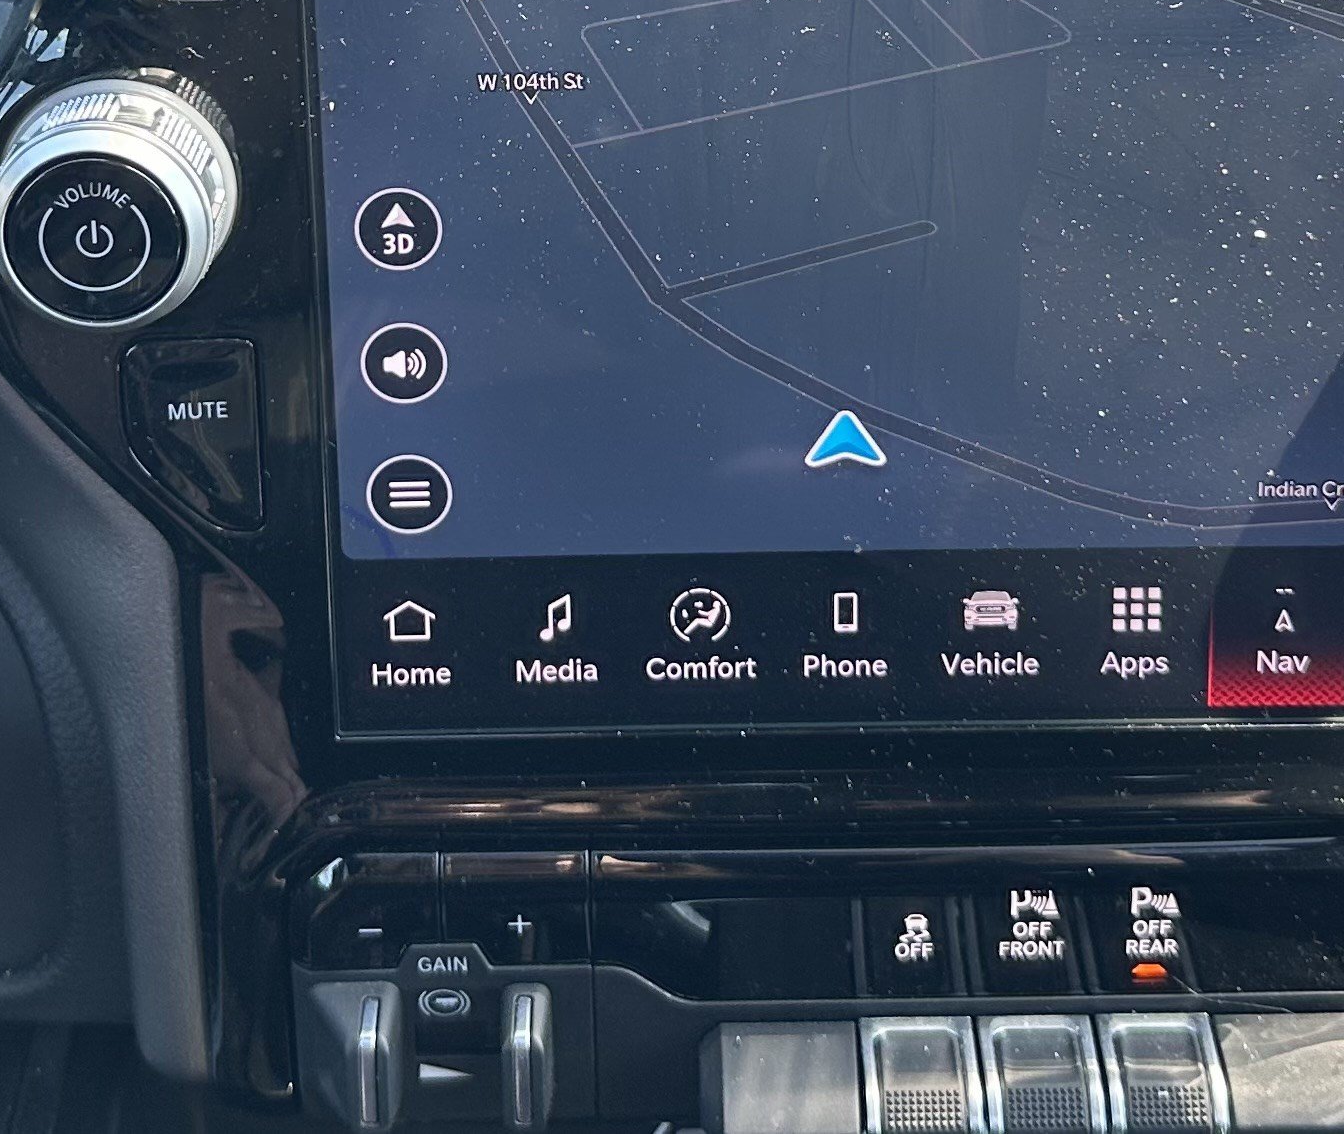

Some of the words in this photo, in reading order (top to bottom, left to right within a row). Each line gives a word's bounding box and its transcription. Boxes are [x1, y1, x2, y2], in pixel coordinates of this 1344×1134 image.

[478, 74, 498, 91] W
[504, 73, 559, 91] 104th
[563, 73, 583, 90] St
[53, 182, 132, 211] VOLUME
[383, 234, 414, 255] 3D
[167, 401, 229, 420] MUTE
[1259, 481, 1318, 497] Indian
[516, 658, 598, 685] Media
[646, 655, 757, 682] Comfort
[803, 654, 889, 679] Phone
[941, 651, 1040, 677] Vehicle
[1101, 651, 1170, 679] Apps
[1256, 650, 1310, 674] Nav
[372, 663, 452, 687] Home
[1012, 921, 1052, 939] OFF
[1132, 919, 1173, 937] OFF
[894, 941, 933, 960] OFF
[999, 940, 1064, 959] FRONT
[1125, 938, 1179, 957] REAR
[418, 957, 468, 973] GAIN
